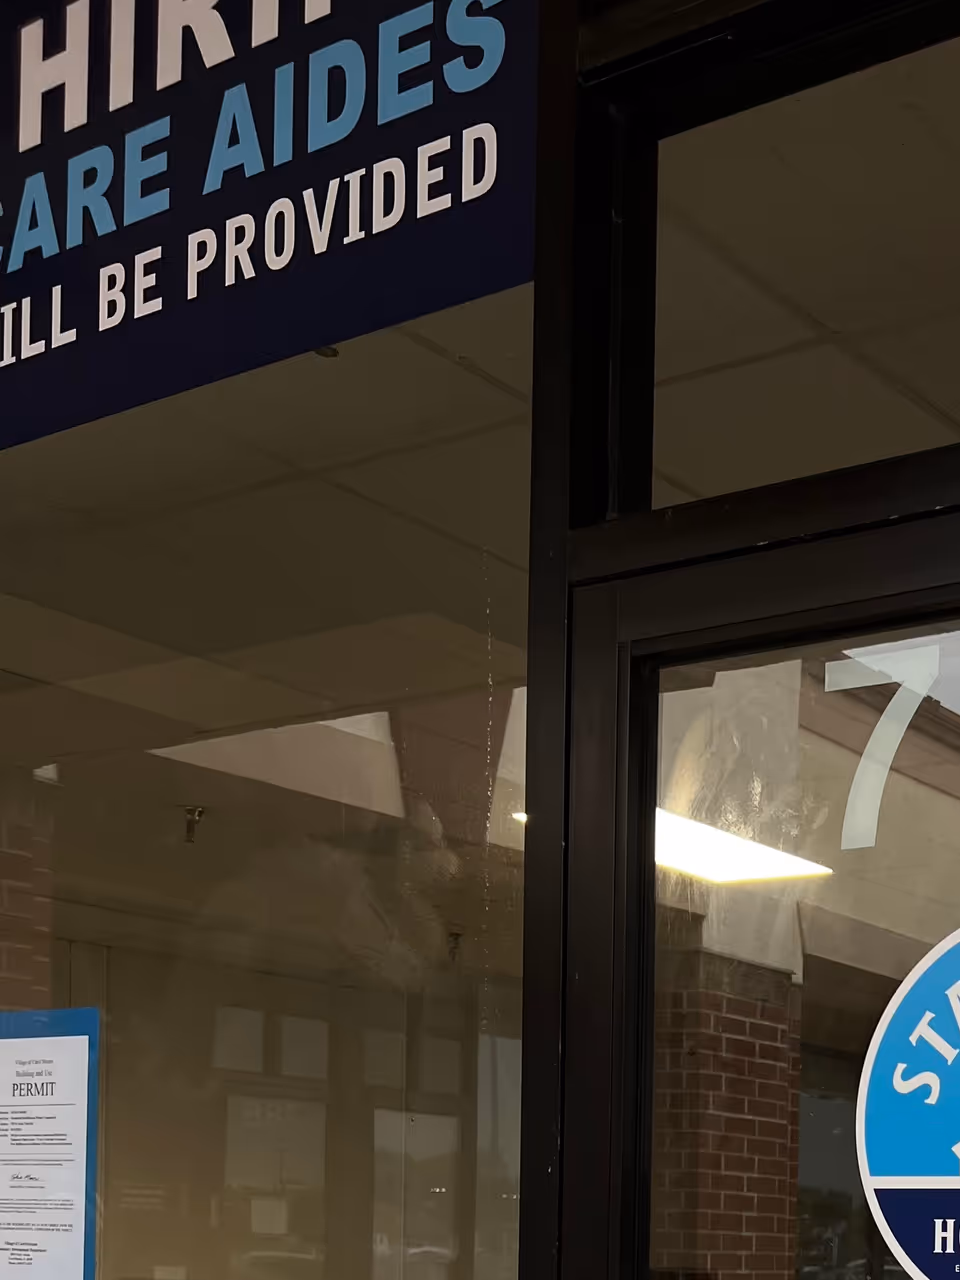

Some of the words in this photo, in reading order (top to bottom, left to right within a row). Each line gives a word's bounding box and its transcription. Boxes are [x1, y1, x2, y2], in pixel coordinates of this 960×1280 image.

[0, 115, 170, 273] ARE
[202, 0, 506, 195] AIDES
[19, 0, 331, 152] HIR
[0, 285, 77, 367] ILL
[99, 246, 163, 331] BE
[187, 122, 498, 300] PROVIDED
[12, 1082, 56, 1097] PERMIT
